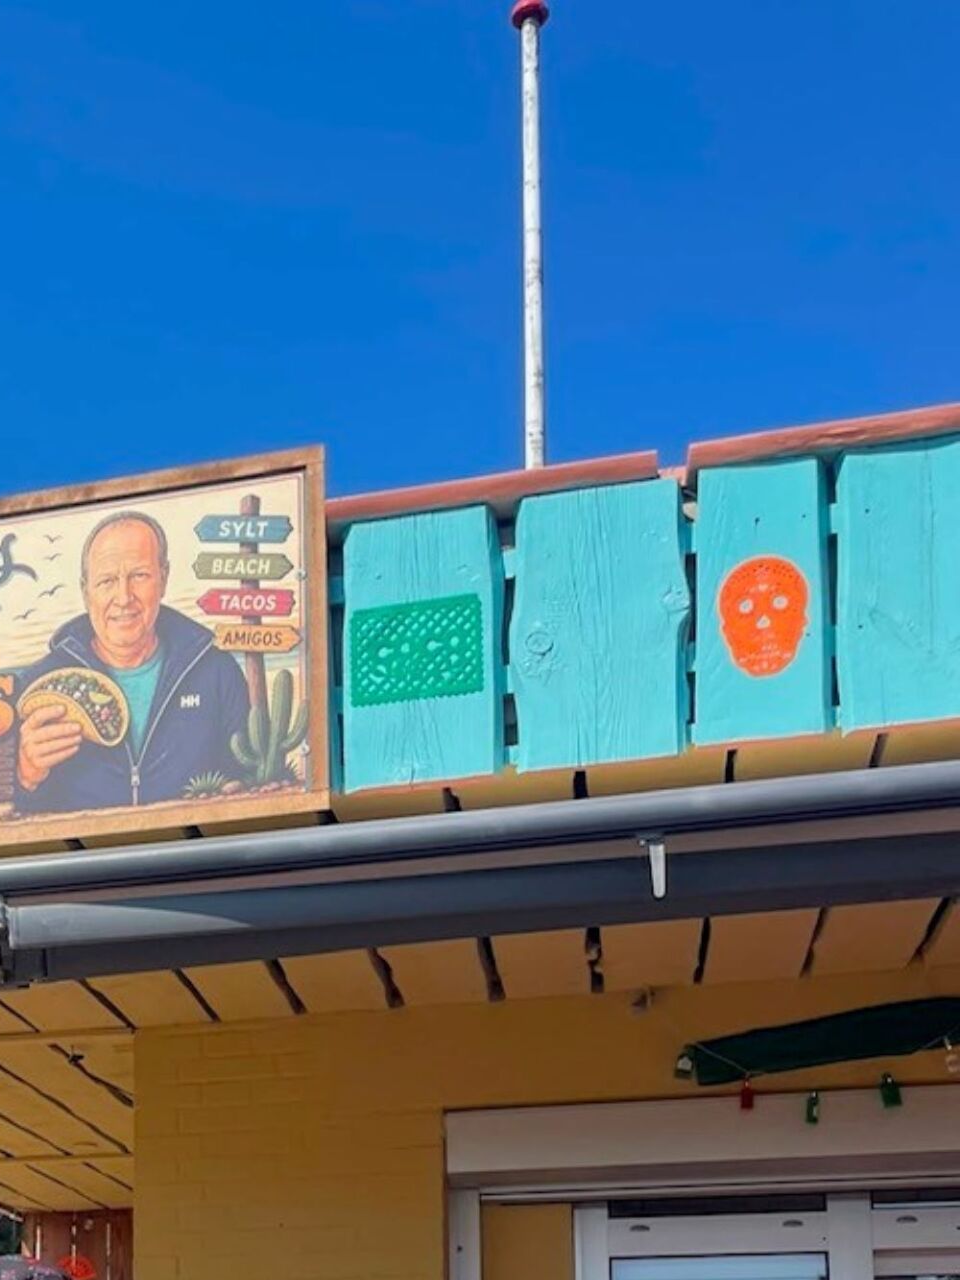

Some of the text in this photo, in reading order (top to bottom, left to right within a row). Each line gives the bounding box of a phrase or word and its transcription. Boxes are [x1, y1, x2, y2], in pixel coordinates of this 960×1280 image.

[218, 520, 269, 539] SYLT
[210, 558, 271, 575] BEACH
[218, 594, 277, 612] TACOS
[222, 630, 283, 647] AMIGOS
